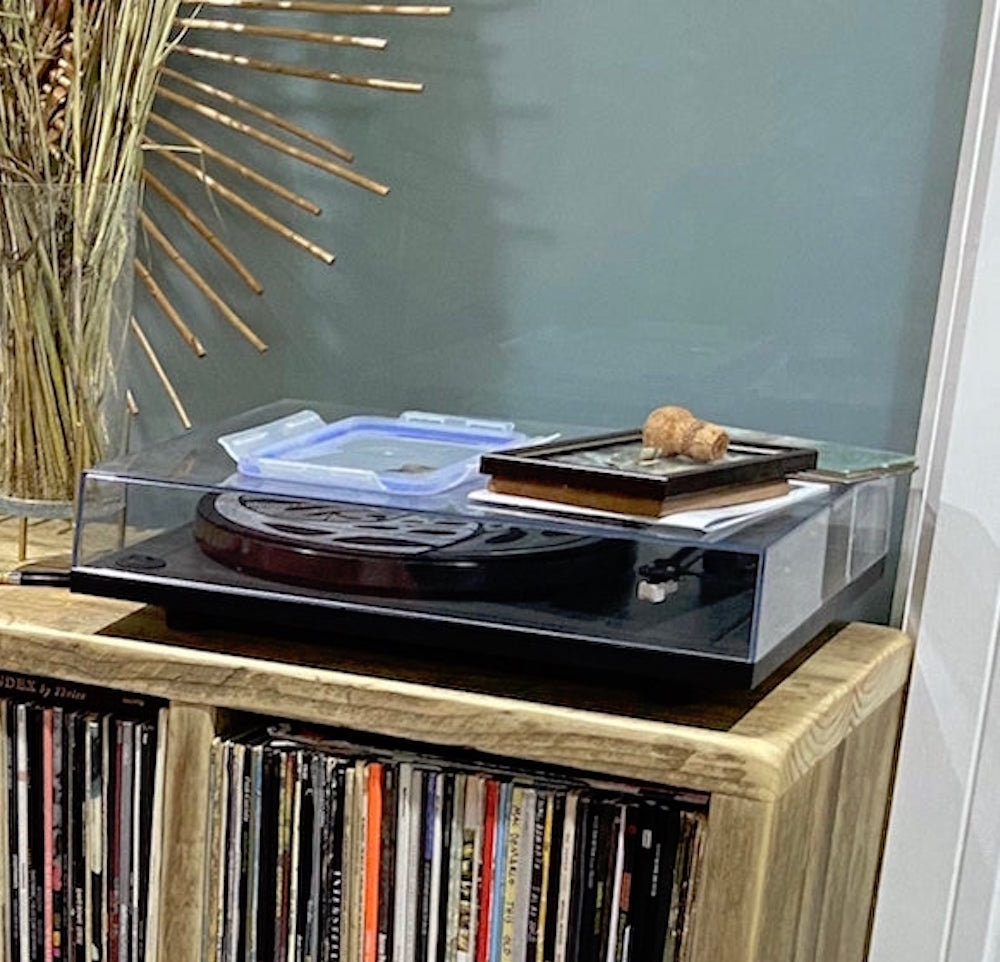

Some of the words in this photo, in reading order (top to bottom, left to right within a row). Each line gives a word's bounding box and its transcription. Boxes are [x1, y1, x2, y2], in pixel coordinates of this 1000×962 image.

[39, 683, 51, 699] by
[53, 686, 87, 701] Thrice
[511, 805, 522, 827] MAC
[508, 832, 520, 886] DEMARCO
[504, 900, 515, 924] THIS
[502, 934, 512, 956] OLD
